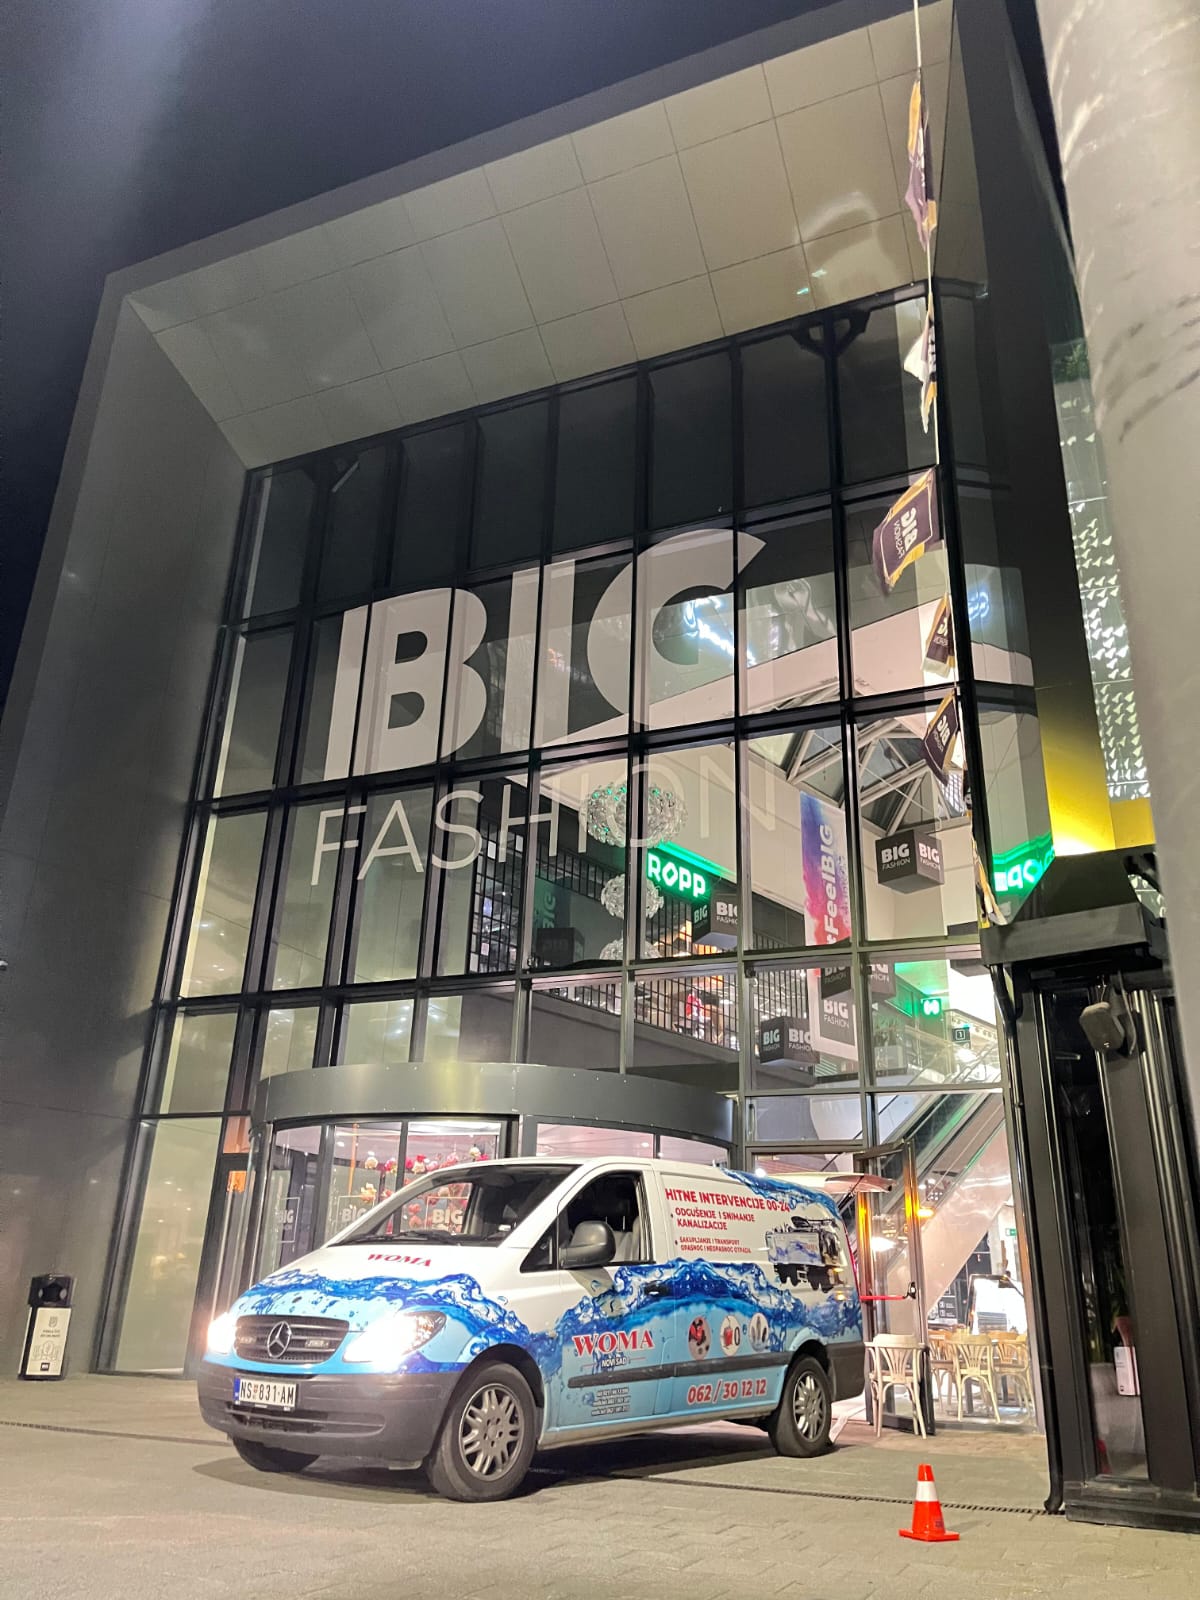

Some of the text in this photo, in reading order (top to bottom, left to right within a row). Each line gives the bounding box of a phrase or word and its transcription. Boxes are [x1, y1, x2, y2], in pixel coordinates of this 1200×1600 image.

[323, 528, 767, 782] BIG
[311, 749, 778, 887] FASHION
[881, 843, 910, 864] BIG
[918, 842, 940, 864] BIG
[881, 857, 911, 871] FASHION
[919, 857, 941, 871] FASHION
[693, 904, 708, 924] BIG
[823, 999, 849, 1019] BIG
[823, 1014, 850, 1029] FASHION
[763, 1029, 780, 1045] BIG
[665, 1188, 790, 1212] HITNE INTERVENCIJE 00-24
[432, 1208, 464, 1225] BIG
[677, 1218, 727, 1231] KANALIZACIJE
[722, 1211, 755, 1222] SNIMANJE
[368, 1254, 431, 1267] WOMA
[573, 1330, 654, 1356] WOMA
[601, 1356, 627, 1368] NOVI SAD
[240, 1381, 253, 1399] NS
[741, 1380, 753, 1397] 12
[755, 1378, 767, 1396] 12
